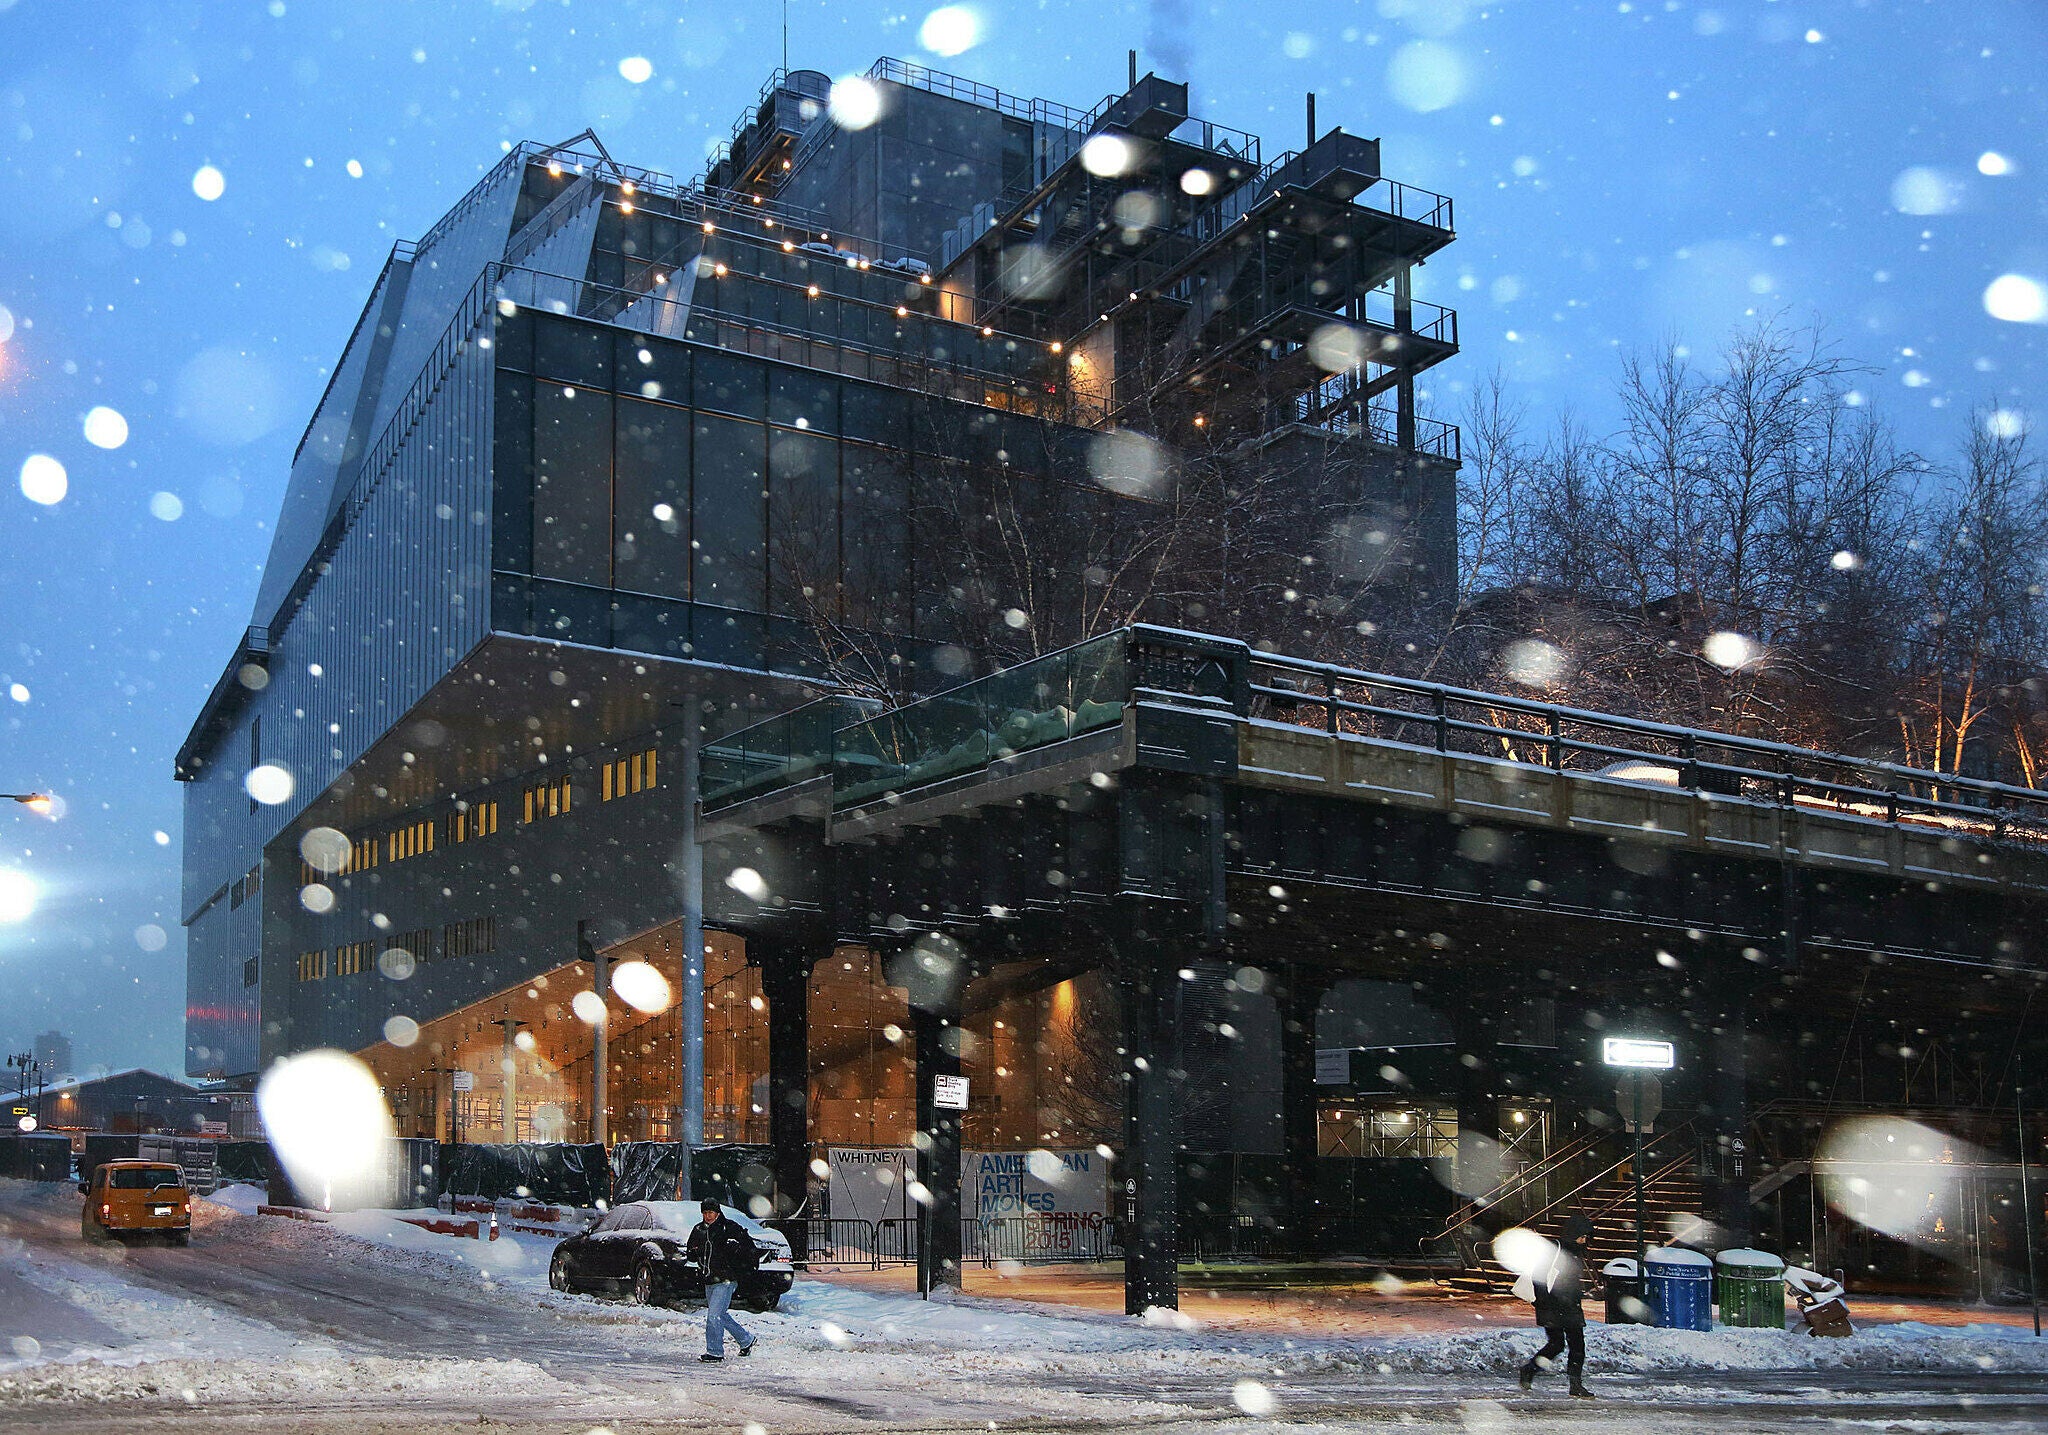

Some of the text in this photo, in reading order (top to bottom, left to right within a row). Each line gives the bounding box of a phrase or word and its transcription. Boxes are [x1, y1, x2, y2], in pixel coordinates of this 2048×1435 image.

[837, 1151, 899, 1164] WHITNEY
[980, 1153, 1090, 1174] AMEAN
[981, 1174, 1024, 1194] ART
[981, 1192, 1056, 1213] MOVES
[1025, 1211, 1104, 1231] SPRING
[1025, 1231, 1072, 1250] 2015
